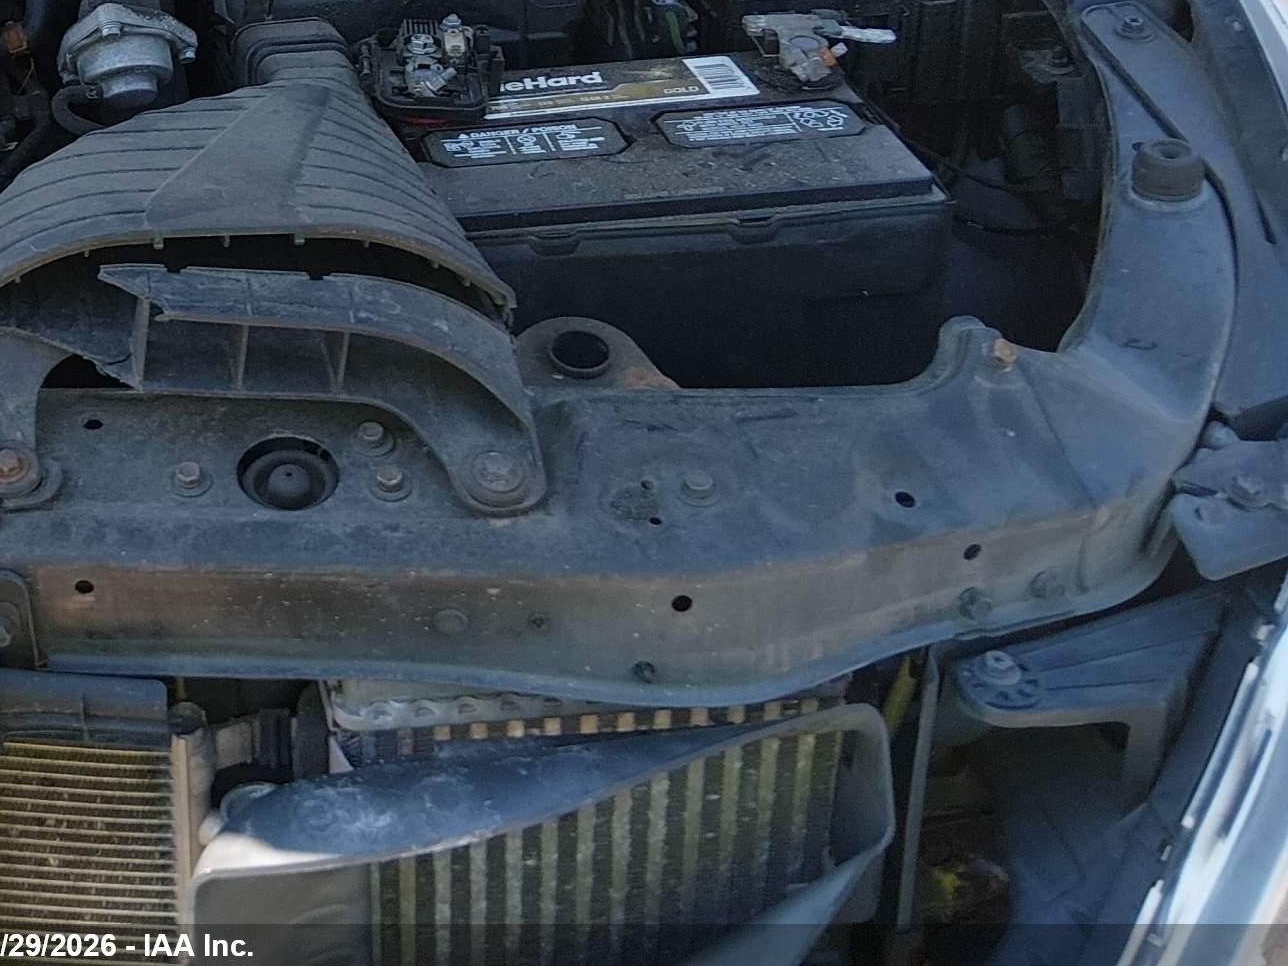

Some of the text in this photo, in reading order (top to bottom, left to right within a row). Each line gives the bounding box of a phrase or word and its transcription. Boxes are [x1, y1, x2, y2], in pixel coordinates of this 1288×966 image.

[663, 86, 700, 95] GOLD
[470, 129, 520, 139] DANGER
[531, 124, 577, 133] POISON
